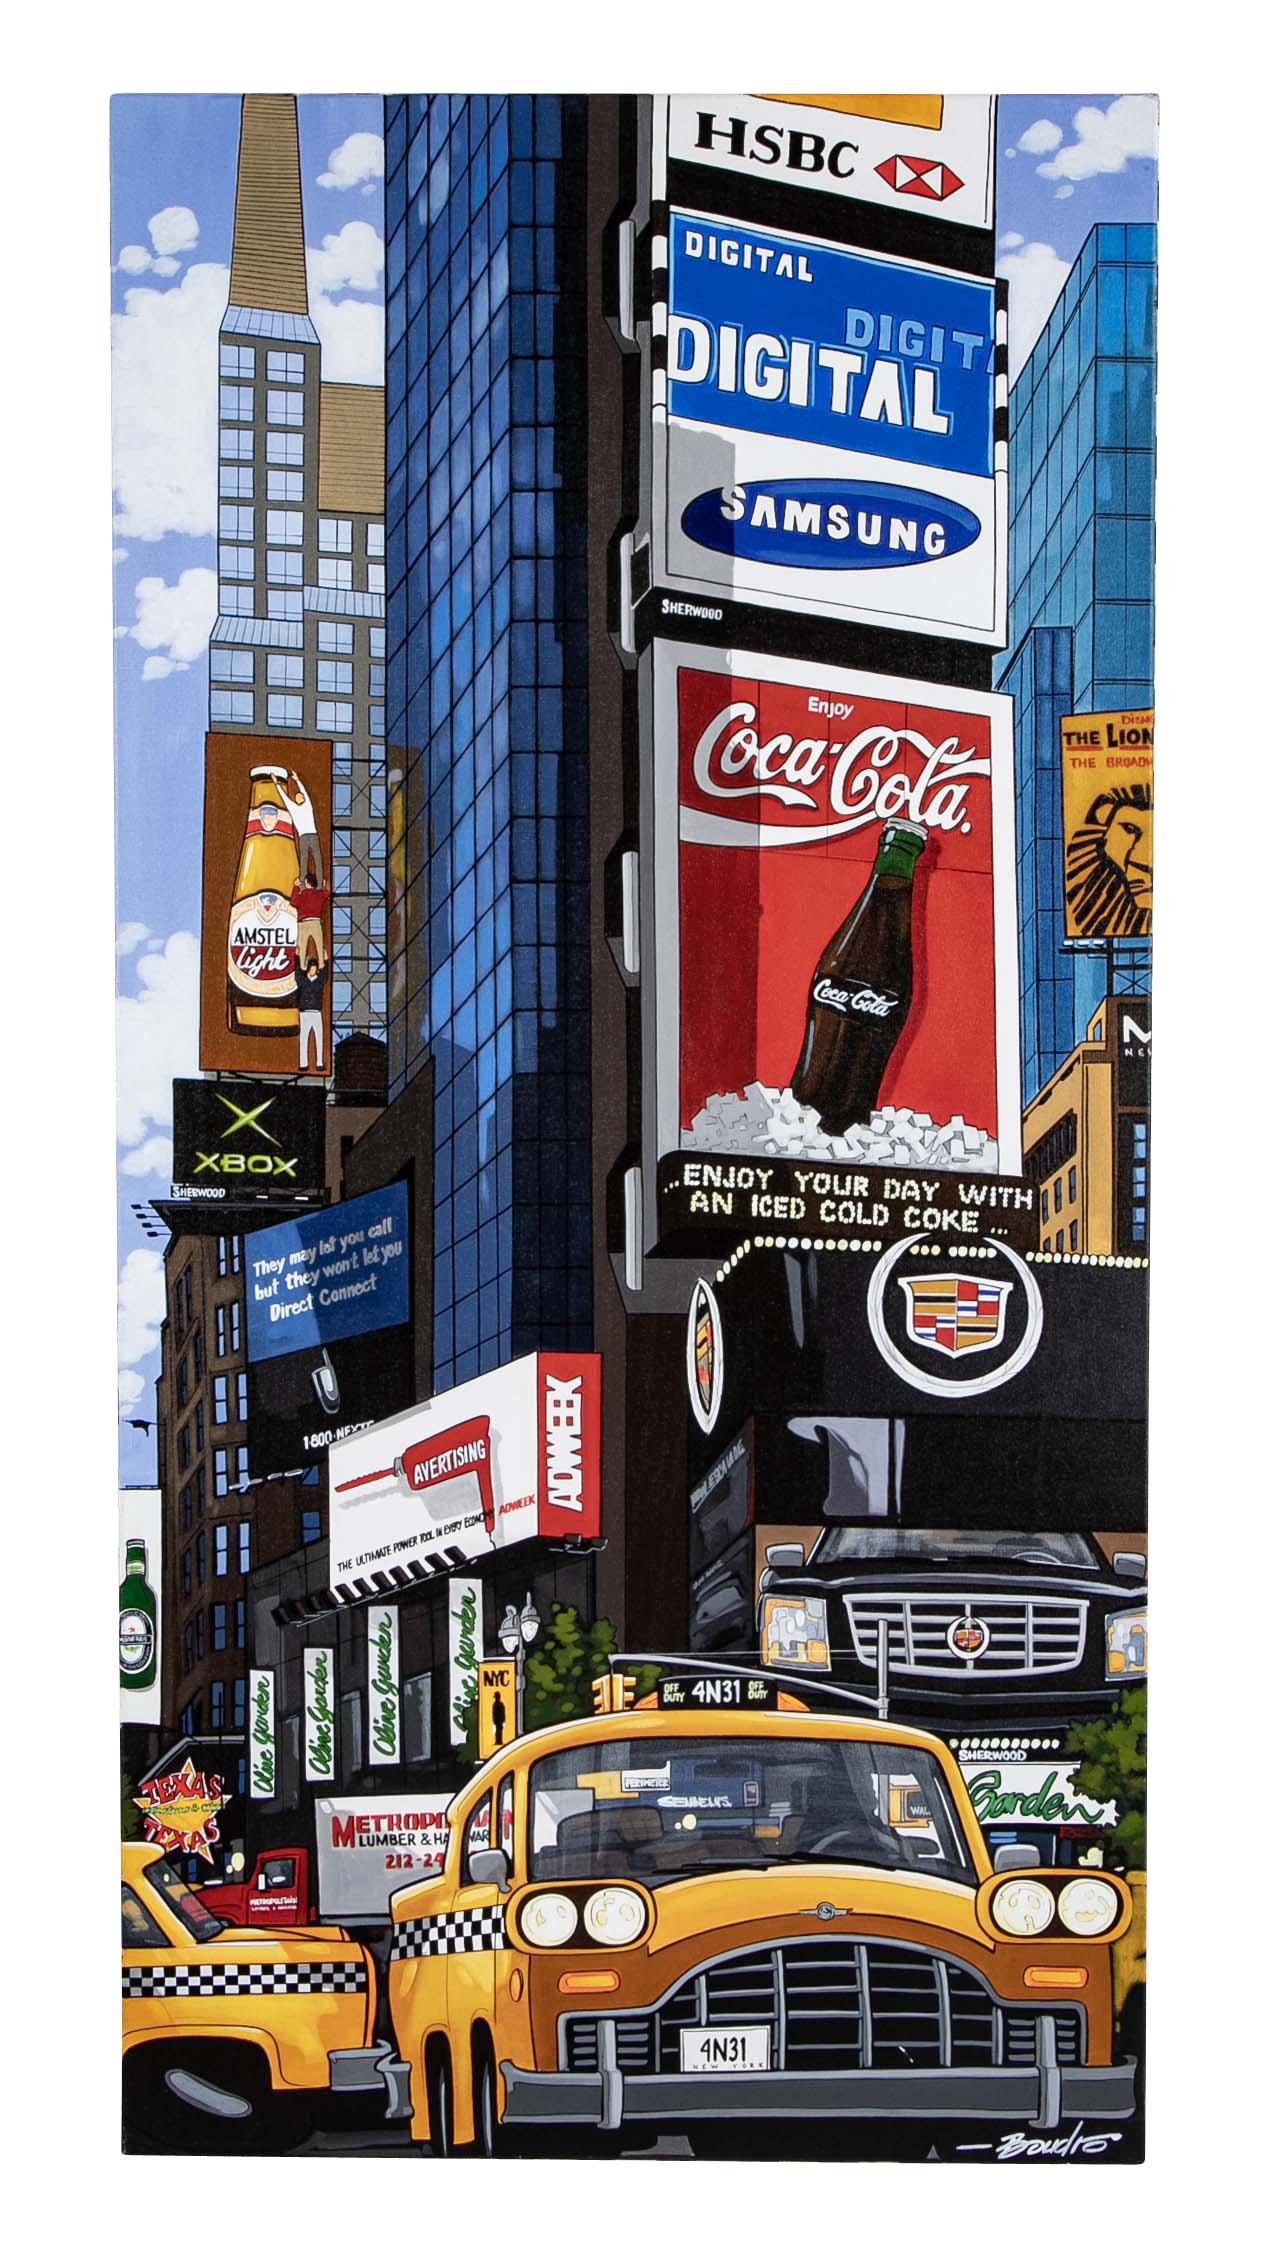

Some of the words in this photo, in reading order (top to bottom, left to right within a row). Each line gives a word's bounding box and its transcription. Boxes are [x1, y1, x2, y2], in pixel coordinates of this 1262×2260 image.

[694, 111, 859, 178] HSBC
[684, 230, 814, 283] DIGITAL
[845, 307, 995, 375] DIGIT
[667, 313, 951, 436] DIGITAL
[720, 485, 947, 557] SAMSUNG
[807, 696, 855, 721] Enjoy
[1063, 730, 1101, 746] THE
[1106, 723, 1155, 748] LION
[1069, 756, 1097, 769] THE
[233, 927, 296, 945] AMSTEL
[236, 945, 290, 978] light
[813, 979, 899, 1018] Coca-Cola
[193, 1151, 299, 1178] XBOX
[794, 1170, 869, 1198] YOUR
[883, 1177, 941, 1202] DAY
[957, 1182, 1034, 1210] WITH
[689, 1190, 733, 1215] AN
[751, 1193, 807, 1220] ICED
[819, 1199, 890, 1227] COLD
[903, 1205, 980, 1234] COKE
[253, 1257, 286, 1278] They
[289, 1245, 317, 1265] may
[339, 1230, 365, 1254] you
[368, 1216, 393, 1238] call
[254, 1278, 280, 1301] but
[285, 1269, 320, 1290] they
[362, 1244, 380, 1266] let
[381, 1240, 403, 1266] you
[269, 1292, 315, 1322] Direct
[319, 1272, 378, 1306] Connect
[545, 1374, 583, 1514] ADWEEK
[336, 1558, 353, 1573] THE
[355, 1544, 393, 1567] ULTIMATE
[393, 1535, 418, 1553] POWER
[418, 1530, 435, 1545] TOOL
[498, 1494, 536, 1517] ADWEEK
[483, 1669, 511, 1688] NYC
[663, 1682, 680, 1693] OFF
[691, 1679, 741, 1704] 4N31
[747, 1689, 769, 1700] DUTY
[748, 1680, 764, 1691] OFF
[663, 1692, 686, 1703] DUTY
[958, 1750, 1028, 1762] SHERWOOD
[140, 1771, 225, 1806] TEXAS
[967, 1769, 1105, 1824] Garden
[143, 1816, 221, 1854] TEXAS
[359, 1833, 421, 1848] LUMBER
[420, 1834, 432, 1846] &
[700, 2036, 746, 2063] 4N31
